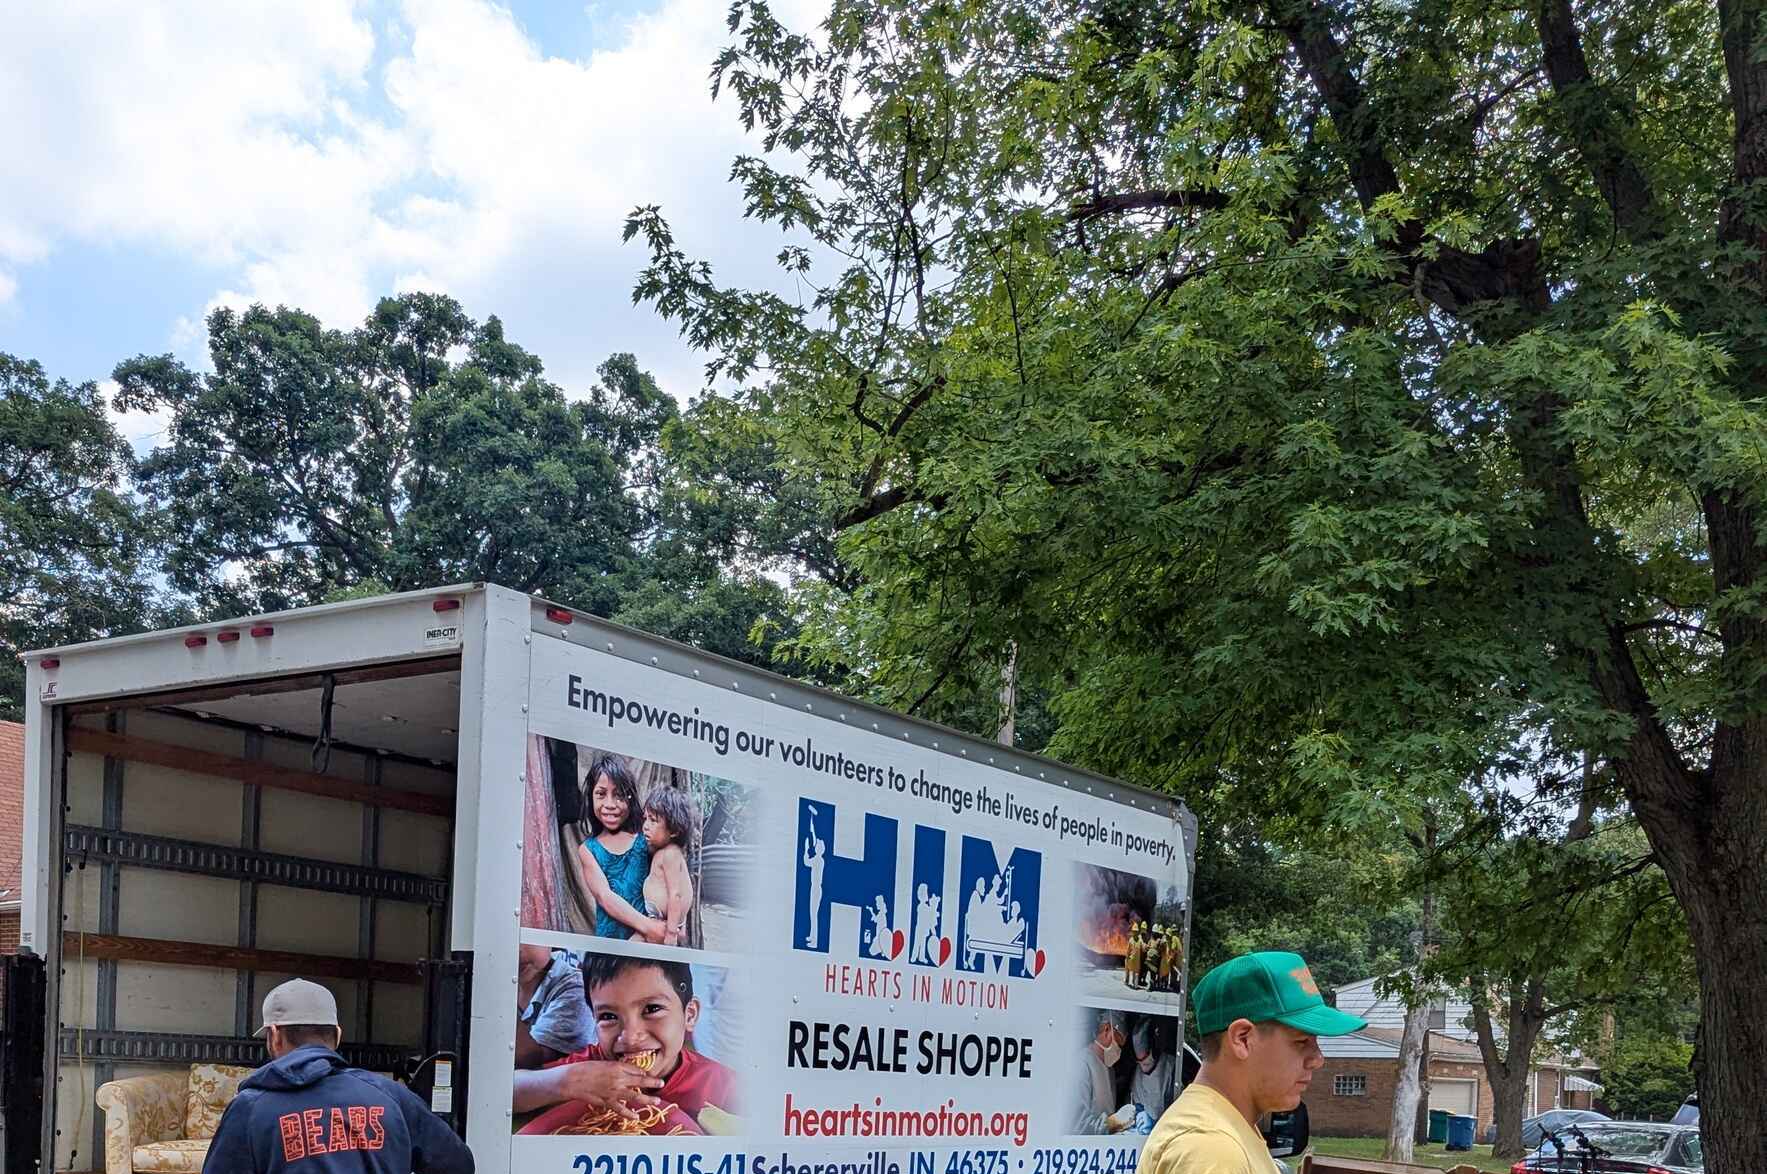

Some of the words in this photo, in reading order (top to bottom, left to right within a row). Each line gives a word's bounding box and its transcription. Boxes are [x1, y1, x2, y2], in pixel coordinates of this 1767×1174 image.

[568, 674, 729, 755] Empowering
[736, 730, 774, 758] our
[779, 738, 884, 787] volunteers
[888, 766, 906, 791] to
[911, 770, 972, 814] change
[977, 786, 1001, 816] the
[1005, 793, 1039, 825] lives
[1042, 806, 1058, 830] of
[1060, 816, 1107, 847] people
[1111, 822, 1122, 845] in
[1125, 836, 1176, 865] poverty.
[825, 964, 902, 999] HEARTS
[913, 975, 931, 1003] IN
[942, 978, 1009, 1010] MOTION
[787, 1020, 909, 1073] RESALE
[916, 1030, 1033, 1078] SHOPPE
[279, 1106, 385, 1162] BEARS
[784, 1093, 1028, 1146] heartsinmotion.org
